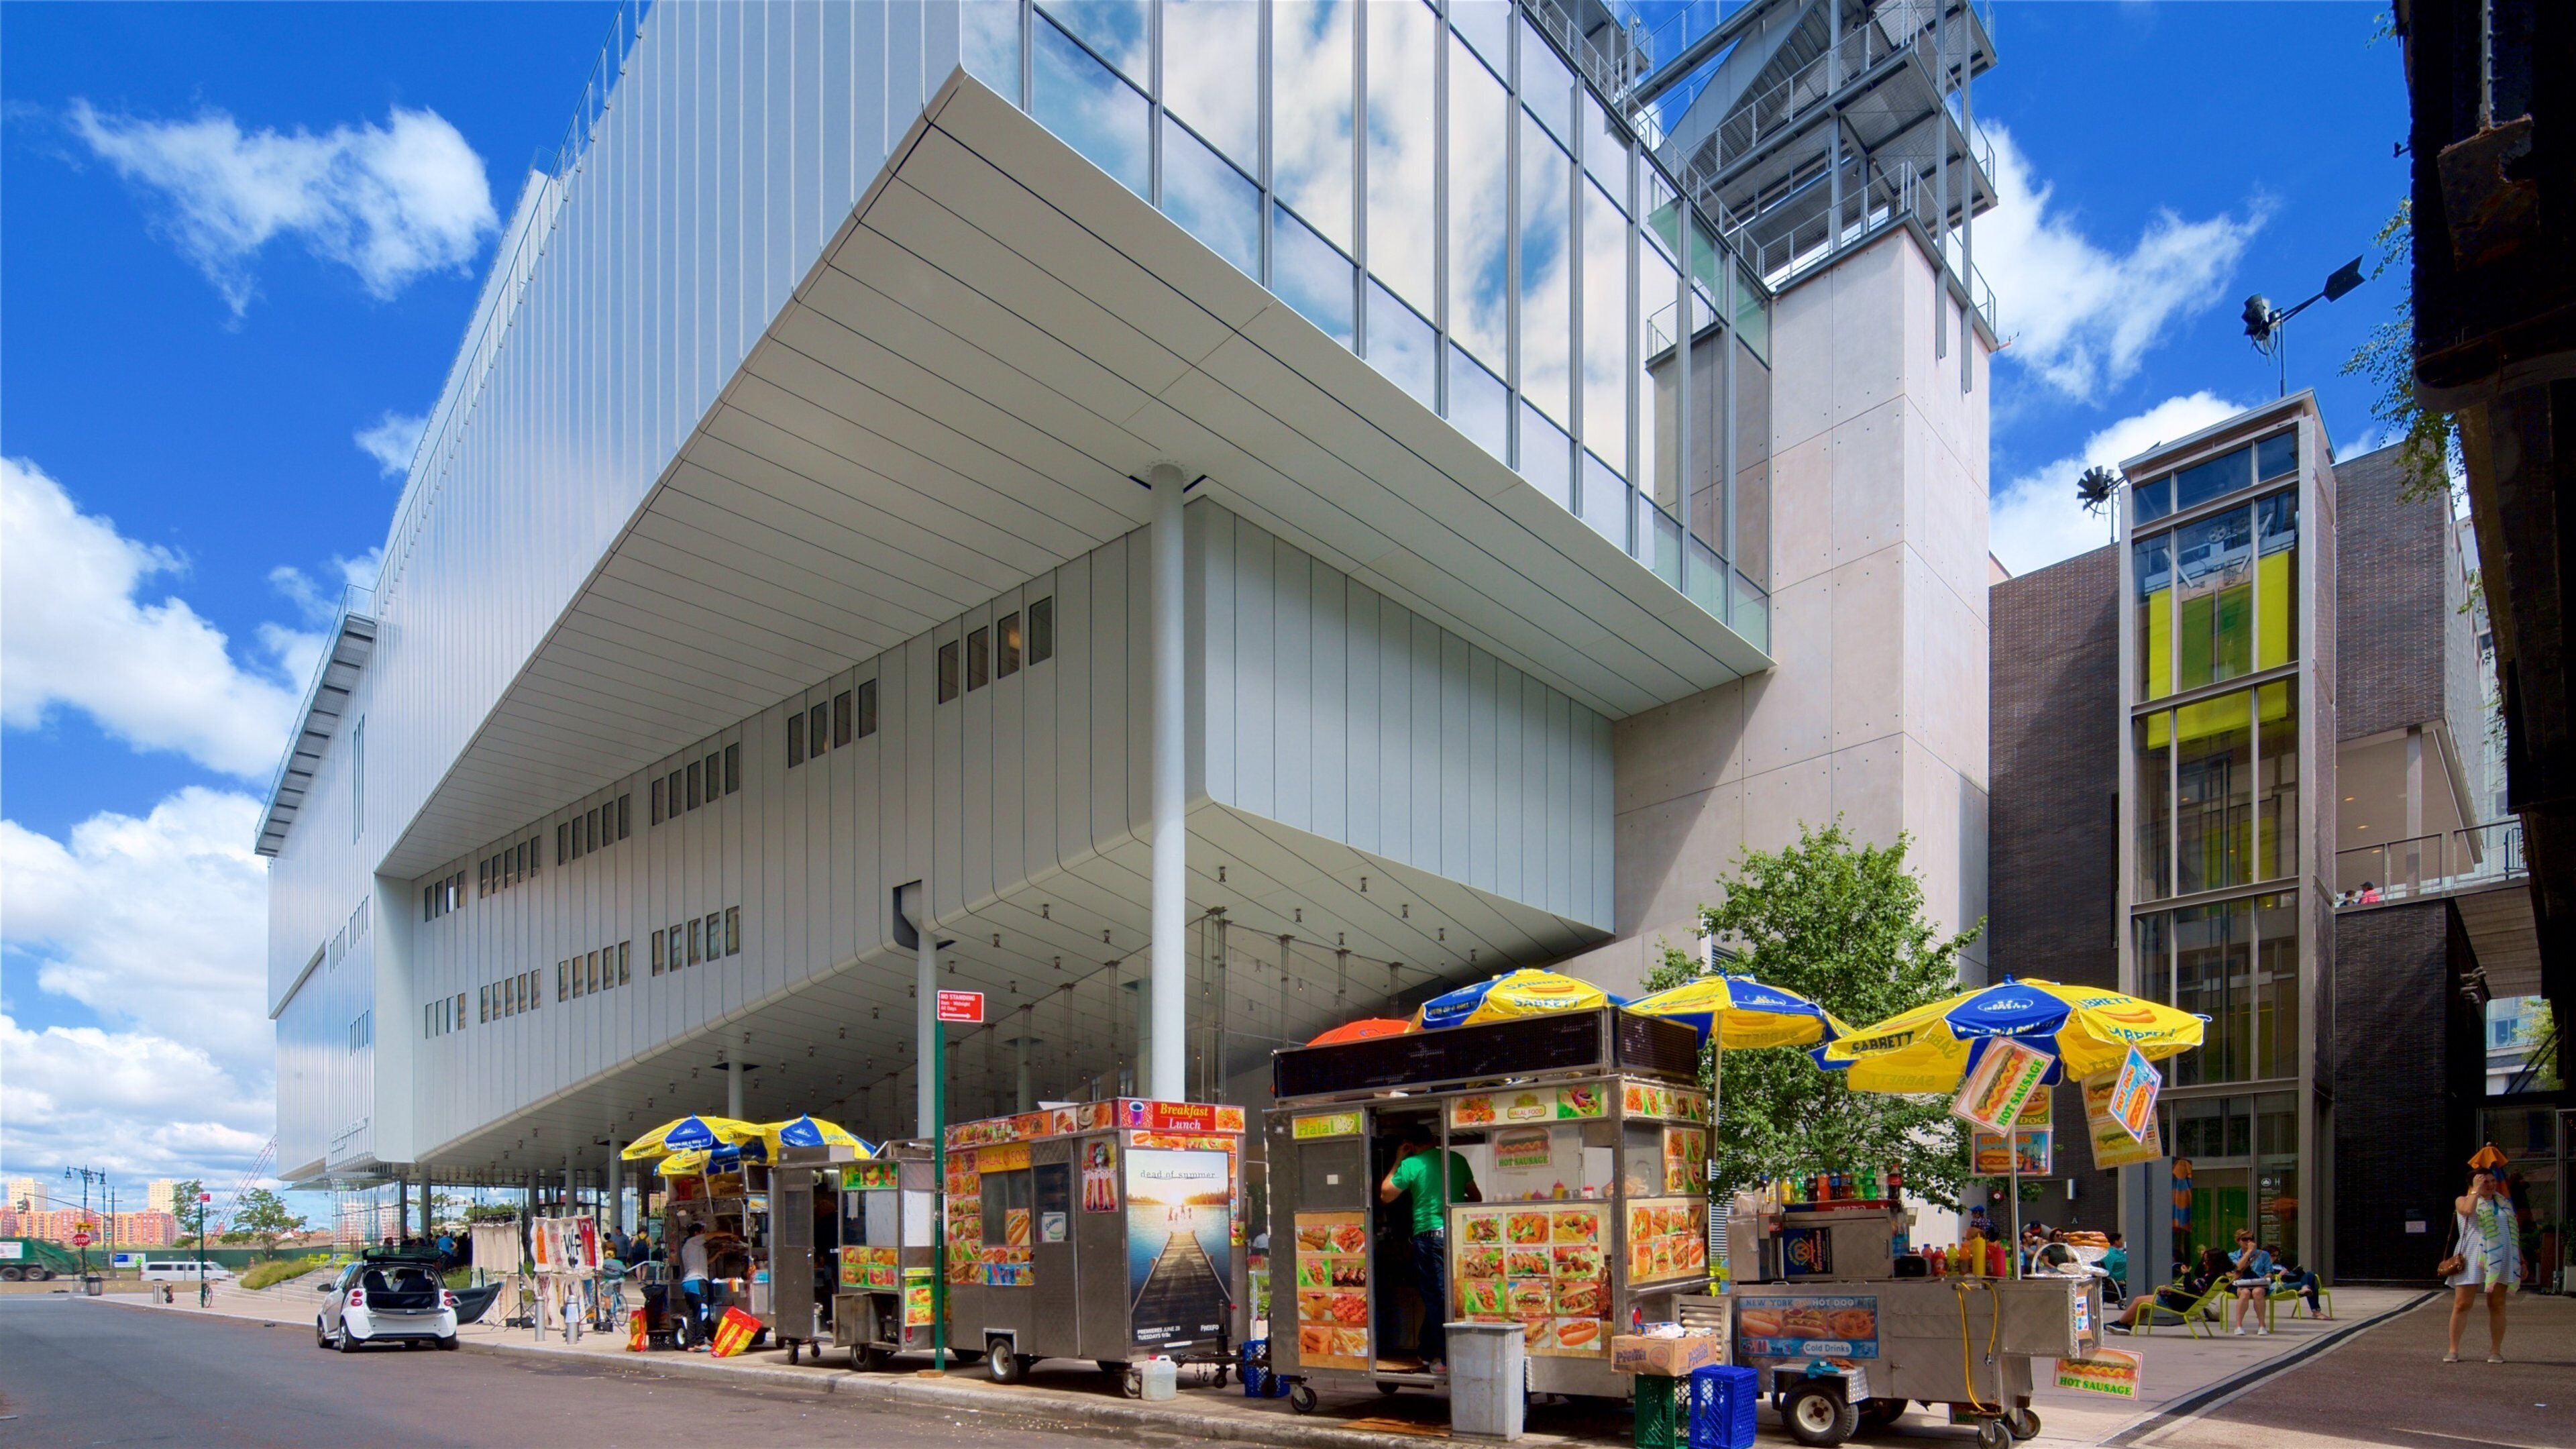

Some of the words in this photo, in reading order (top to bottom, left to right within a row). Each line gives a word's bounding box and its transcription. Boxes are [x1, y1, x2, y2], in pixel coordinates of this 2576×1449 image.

[1505, 979, 1570, 989] SABRETT
[1514, 998, 1579, 1009] SABRETT
[1851, 1030, 1915, 1055] SABRETT
[1996, 1104, 2016, 1127] HOT
[2010, 1058, 2045, 1106] SAUSAGE
[2115, 1088, 2127, 1113] HOT
[2123, 1065, 2136, 1089] DOG
[1160, 1104, 1208, 1118] Breakfast
[1169, 1118, 1201, 1130] Lunch
[2019, 1116, 2046, 1124] DOG
[1297, 1118, 1336, 1135] Halal
[1980, 1136, 2003, 1144] HOT
[979, 1153, 1002, 1166] HALAL
[1010, 1148, 1031, 1162] FOOD
[1498, 1158, 1513, 1167] HOT
[1514, 1156, 1549, 1166] SAUSAGE
[1140, 1169, 1162, 1178] dead
[1166, 1170, 1174, 1178] of
[1805, 1344, 1823, 1352] Cold
[1825, 1344, 1849, 1353] Drinks
[1615, 1350, 1647, 1364] Pretzel
[2059, 1377, 2081, 1387] HOT
[2082, 1380, 2133, 1396] SAUSAGE
[1955, 1413, 1974, 1423] HOT
